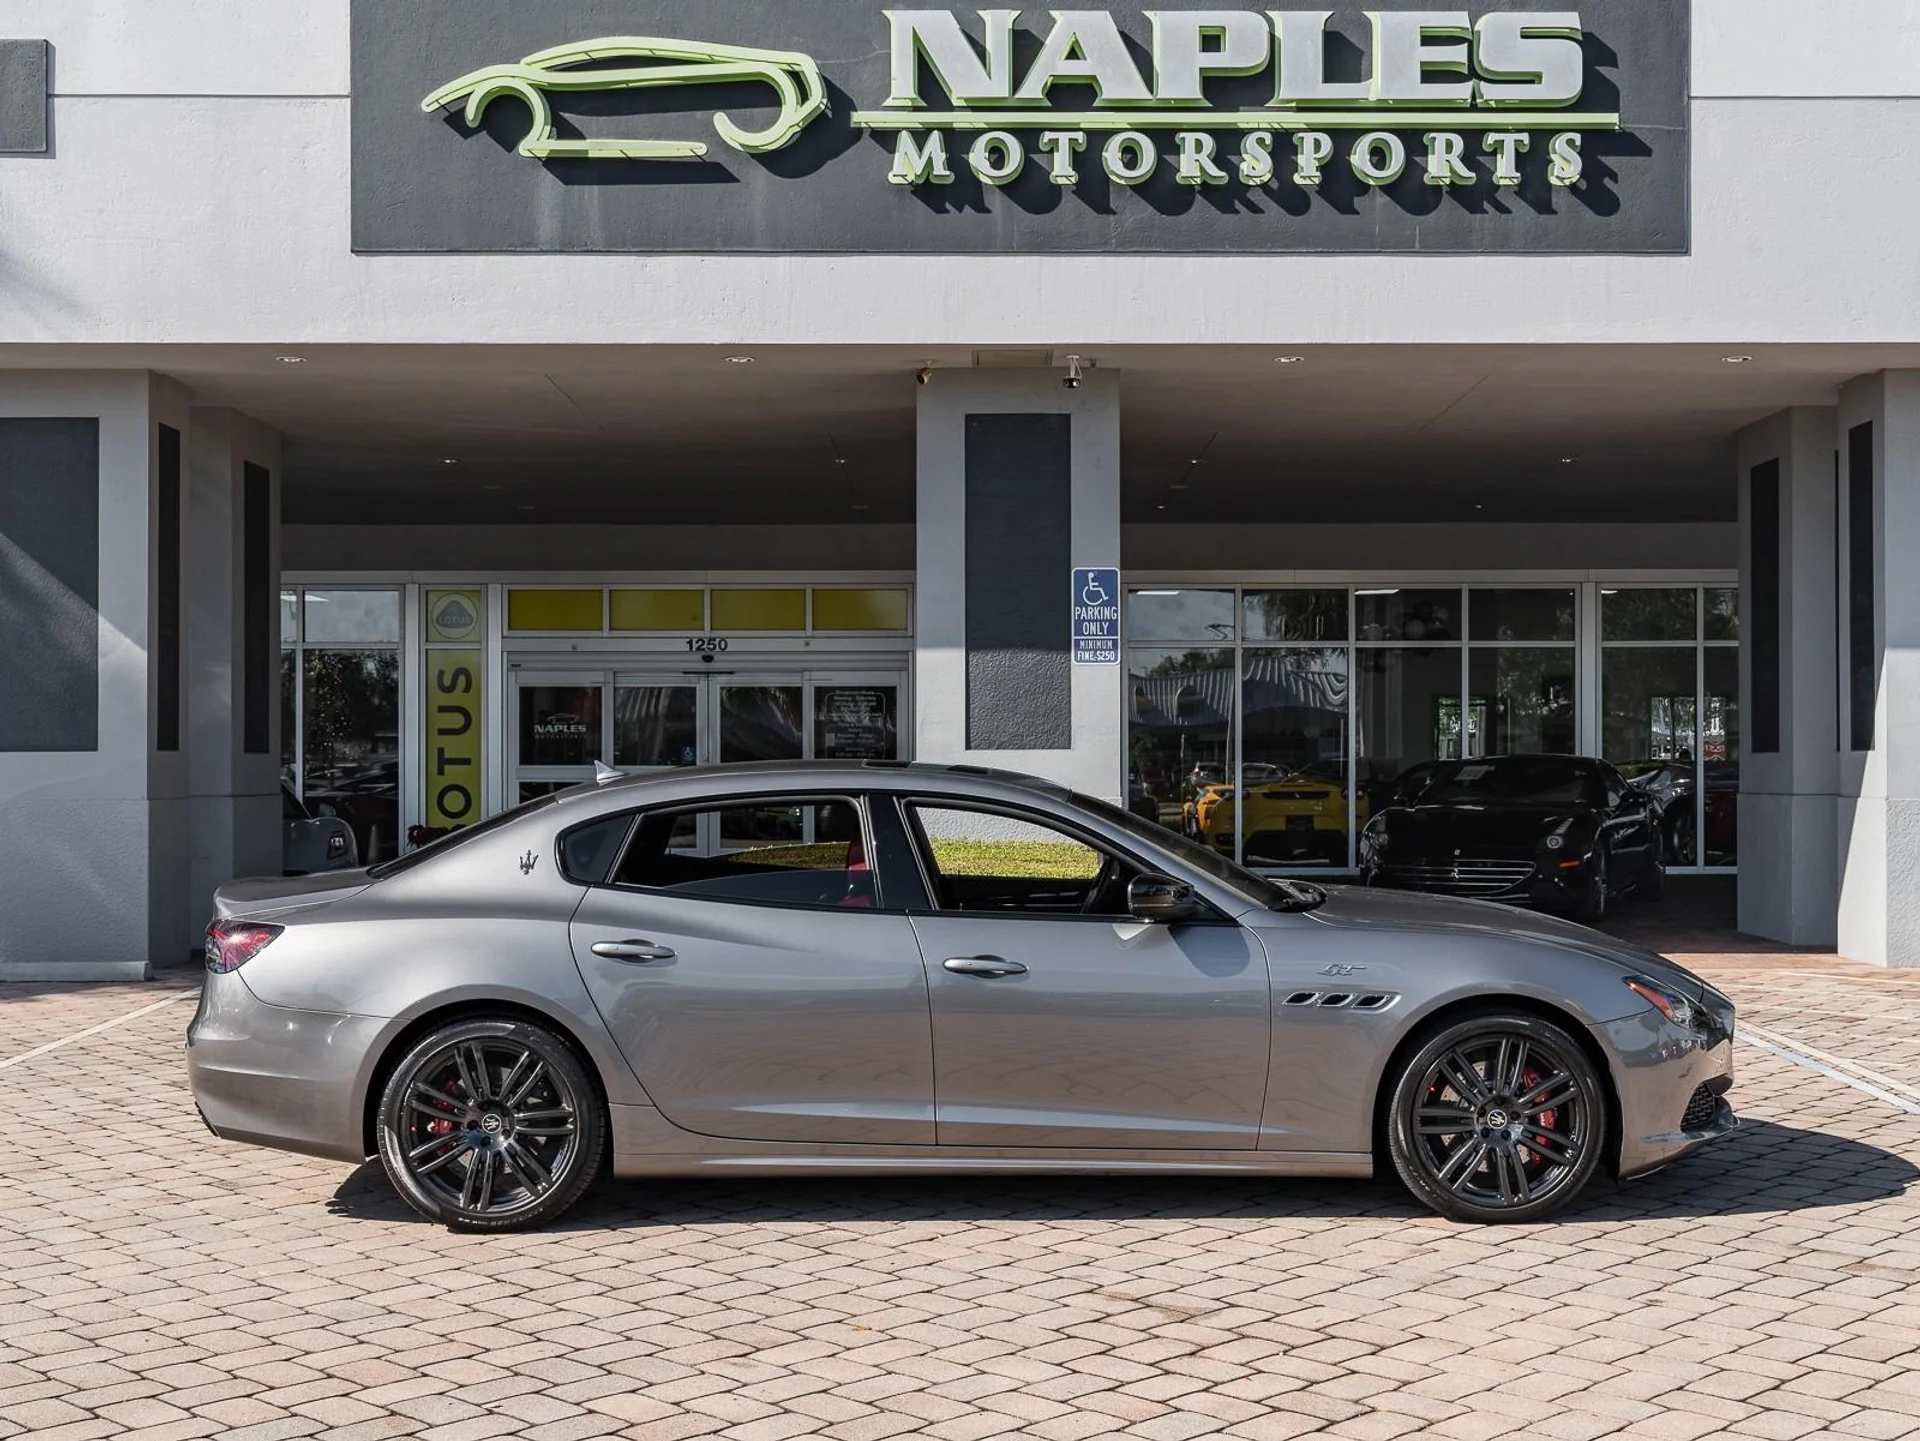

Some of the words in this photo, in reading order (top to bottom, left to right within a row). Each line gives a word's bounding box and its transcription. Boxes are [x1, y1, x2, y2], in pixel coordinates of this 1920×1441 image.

[882, 9, 1585, 107] NAPLES
[887, 130, 1585, 187] MOTORSPORTS
[1075, 606, 1117, 620] PARKING
[1082, 621, 1109, 635] ONLY
[686, 638, 728, 652] 1250
[1079, 639, 1113, 650] MINIMUM
[1077, 651, 1095, 661] FINE
[1096, 651, 1115, 661] $250
[534, 724, 587, 732] NAPLES
[437, 667, 472, 822] OTUS
